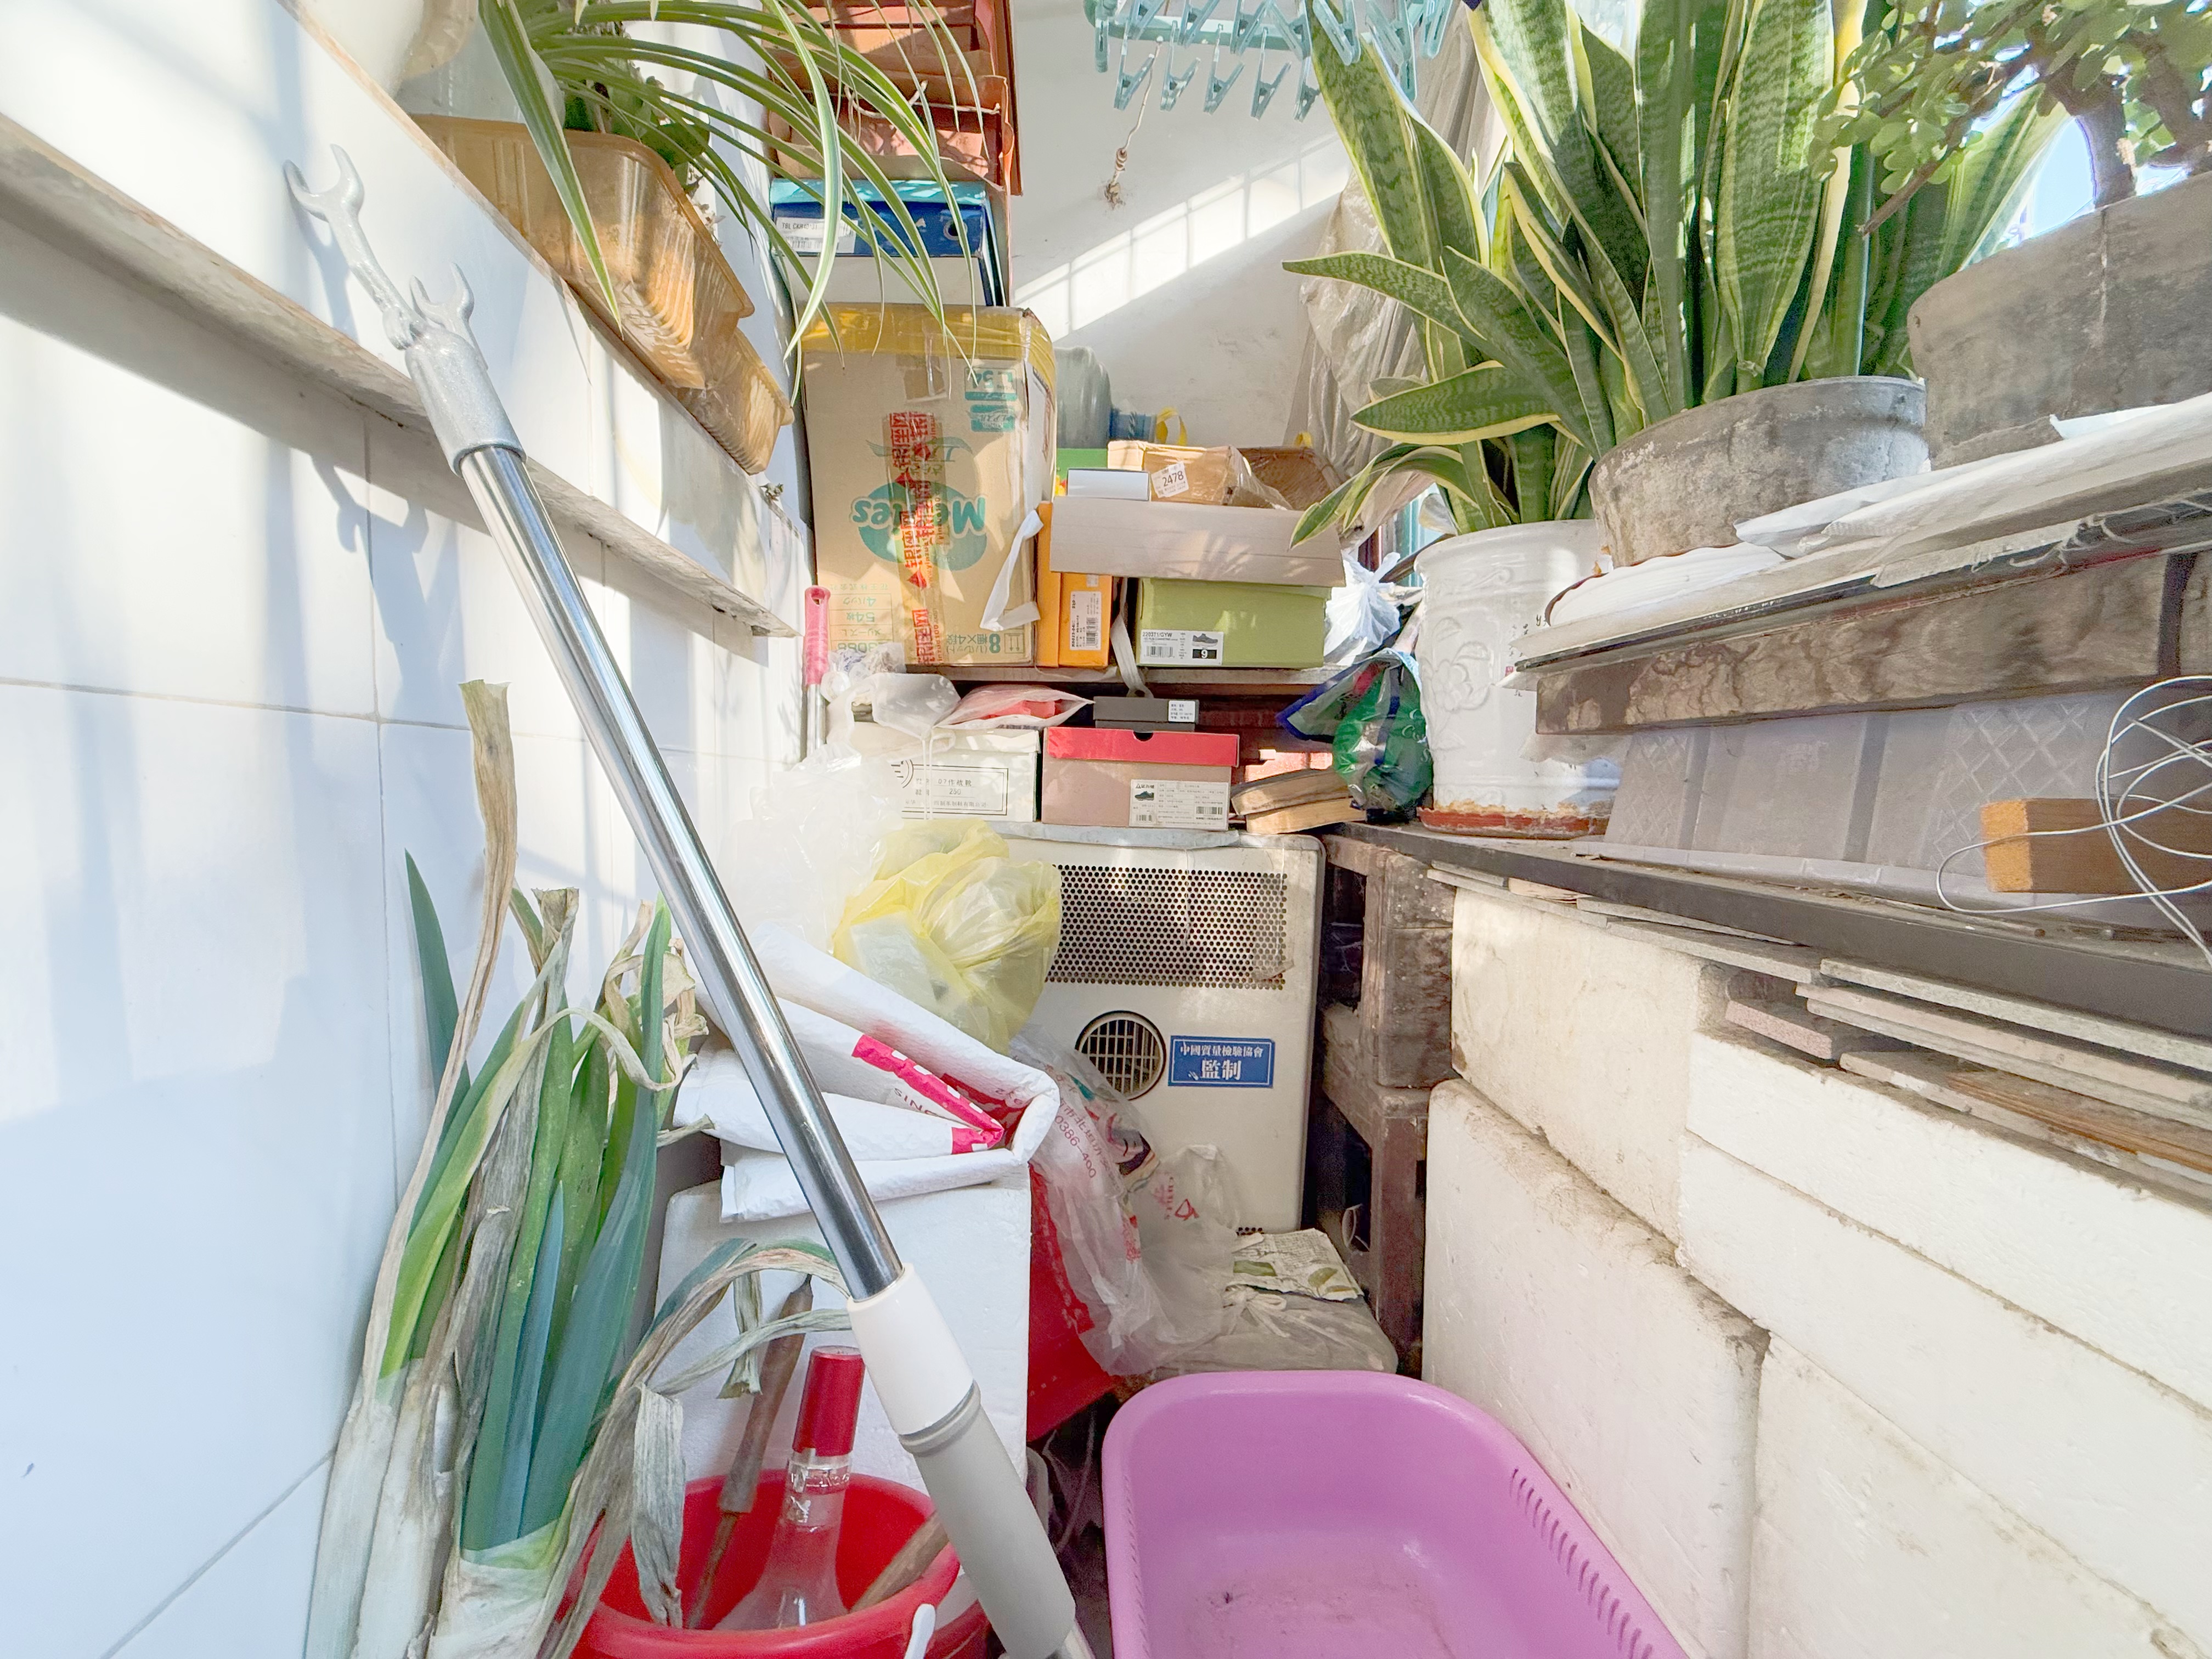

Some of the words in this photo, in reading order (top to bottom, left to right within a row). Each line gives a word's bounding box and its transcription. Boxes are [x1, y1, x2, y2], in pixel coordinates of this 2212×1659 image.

[1162, 470, 1184, 487] 2478
[846, 611, 876, 623] 54枚
[1201, 650, 1208, 659] 9
[1180, 1041, 1263, 1058] 中國質量檢驗協會
[1200, 1058, 1242, 1081] 監制
